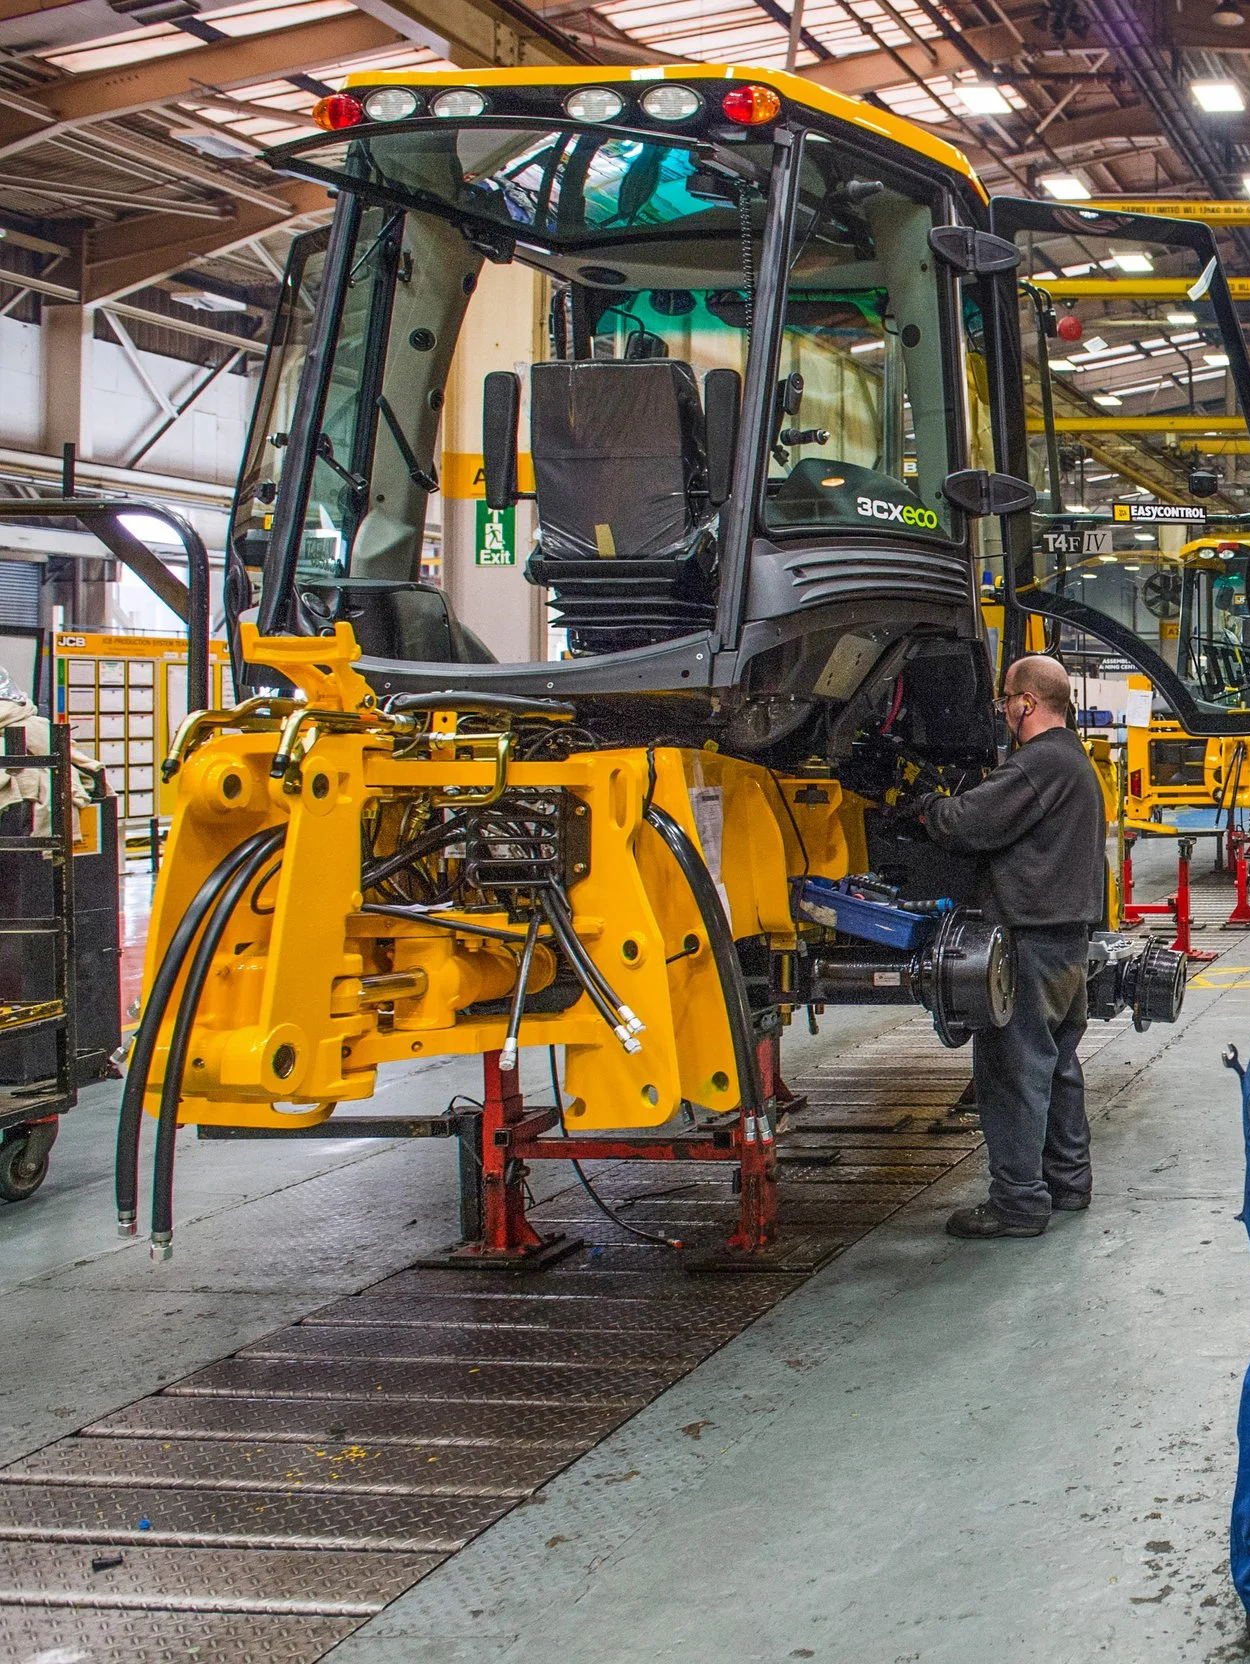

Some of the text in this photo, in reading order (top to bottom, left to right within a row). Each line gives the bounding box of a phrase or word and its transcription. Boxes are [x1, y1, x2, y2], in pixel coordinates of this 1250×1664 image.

[857, 496, 938, 529] 3CXeco
[1131, 505, 1206, 520] EASYCONTROL
[480, 550, 511, 565] Exit
[57, 637, 86, 647] JCB
